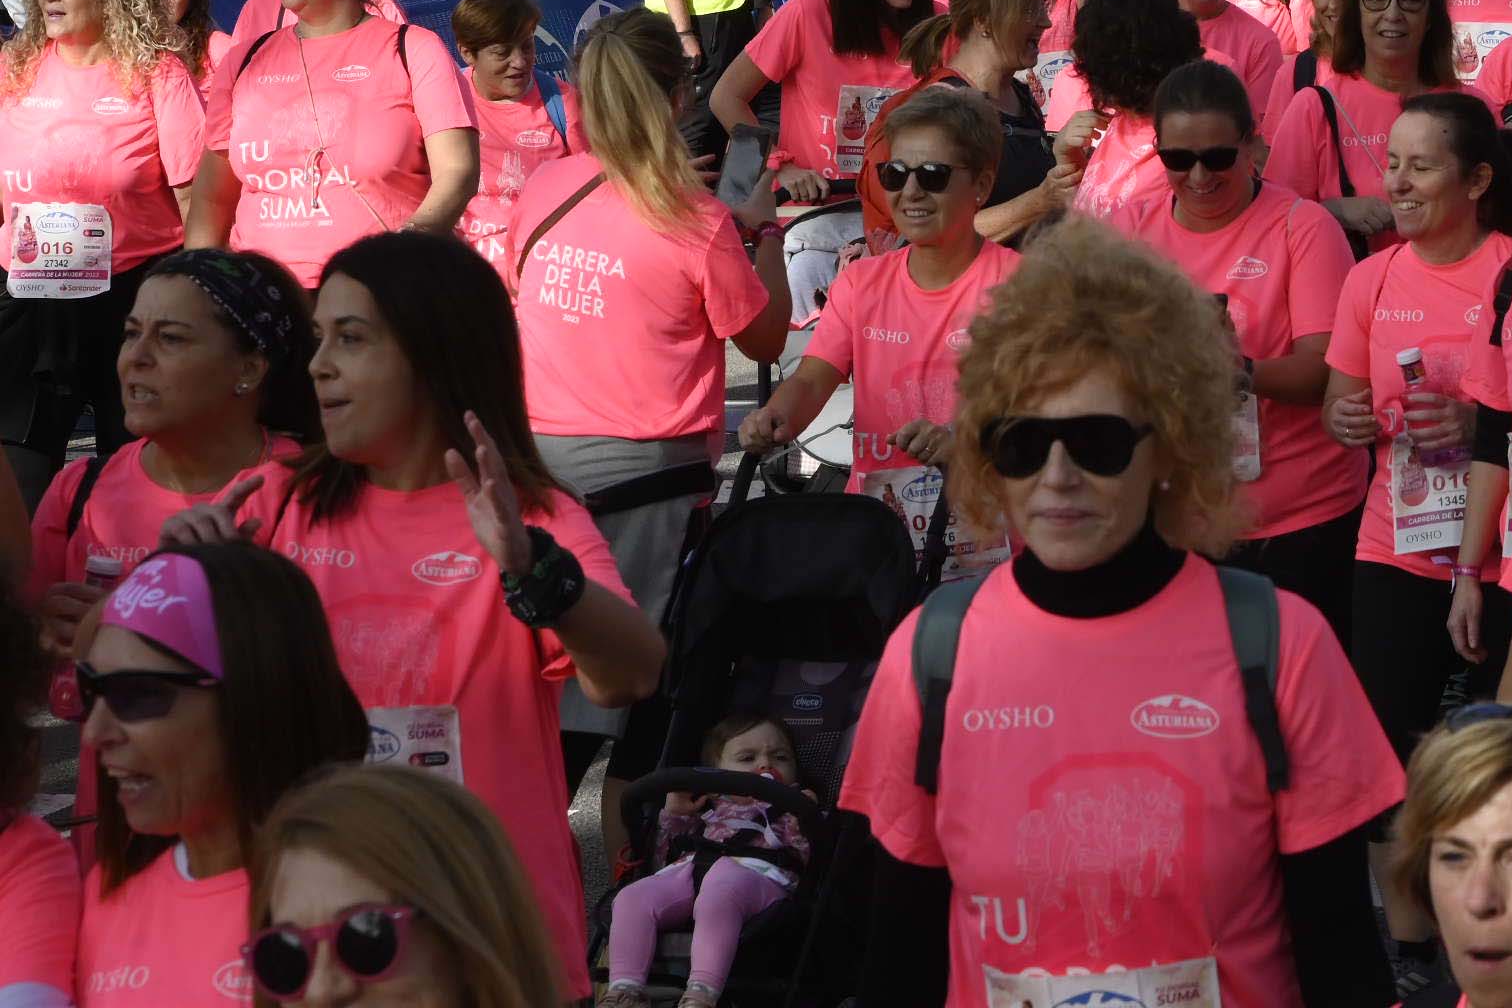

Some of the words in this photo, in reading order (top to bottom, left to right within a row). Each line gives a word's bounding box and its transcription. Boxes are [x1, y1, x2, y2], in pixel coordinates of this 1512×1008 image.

[1343, 132, 1387, 147] OYSHO
[239, 140, 269, 163] TU
[4, 170, 33, 192] TU
[246, 165, 357, 190] DORSAL
[260, 195, 330, 219] SUMA
[41, 242, 73, 255] 016
[44, 259, 69, 268] 27342
[533, 240, 626, 279] CARRERA
[545, 264, 570, 289] DE
[578, 271, 601, 296] LA
[539, 287, 604, 318] MUJER
[1375, 309, 1424, 322] OYSHO
[863, 326, 910, 344] OYSHO
[856, 432, 892, 461] TU
[1408, 514, 1440, 525] CARRERA
[1453, 511, 1463, 520] LA
[1406, 530, 1442, 544] OYSHO
[417, 562, 476, 578] ASTURIANA
[963, 705, 1054, 732] OYSHO
[1138, 709, 1212, 728] ASTURIANA
[407, 729, 445, 740] SUMA
[971, 895, 1027, 944] TU
[1157, 988, 1200, 1007] SUMA
